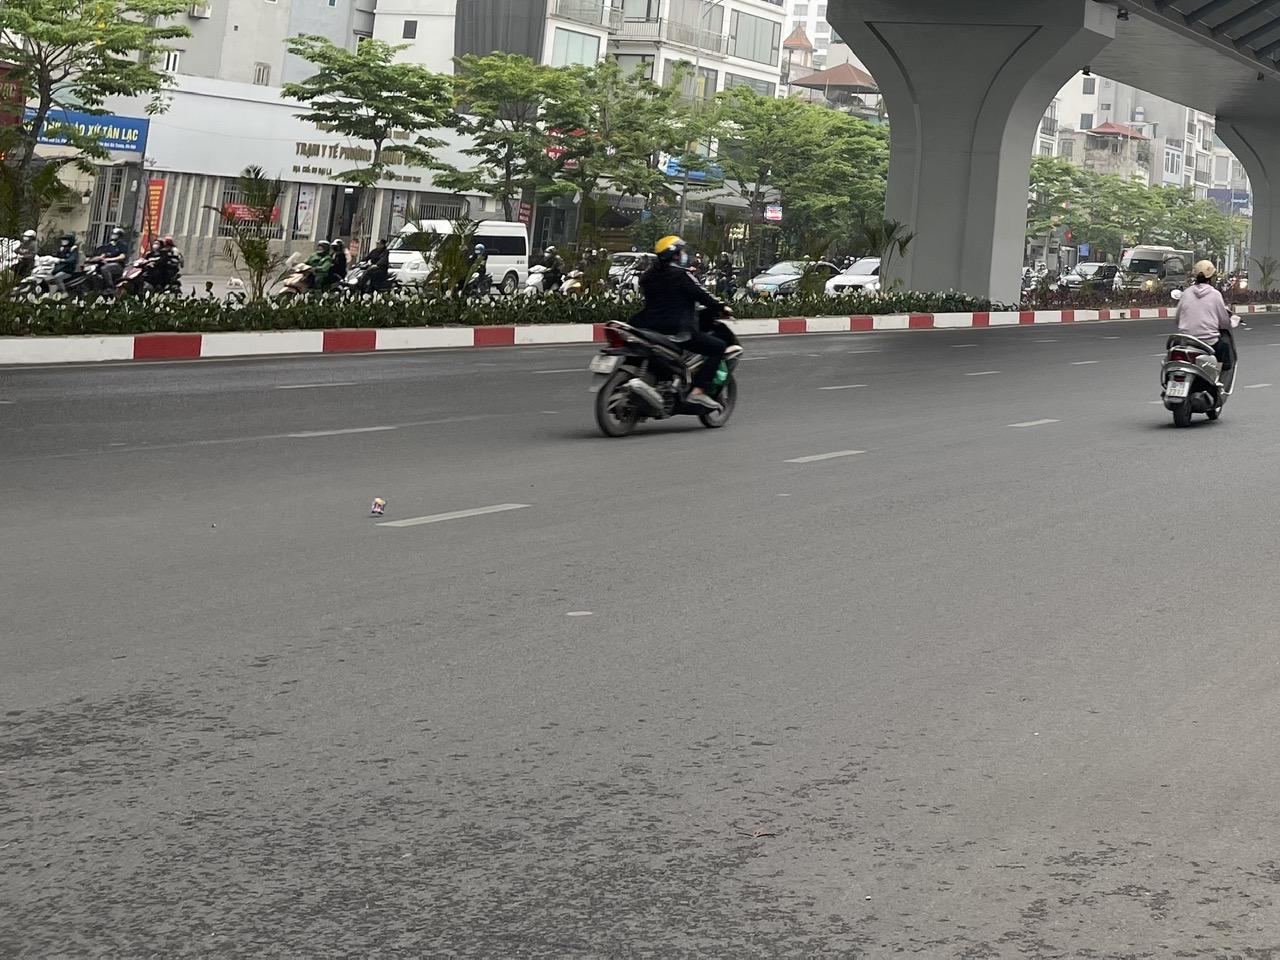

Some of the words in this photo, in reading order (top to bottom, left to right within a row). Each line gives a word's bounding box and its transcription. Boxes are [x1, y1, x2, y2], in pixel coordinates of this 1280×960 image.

[102, 125, 120, 140] TÂN
[121, 128, 139, 143] LẠC
[295, 141, 320, 159] TRẠM
[320, 145, 328, 158] Y
[328, 142, 339, 159] TẾ
[339, 145, 372, 162] PHƯỜNG
[326, 168, 333, 176] LA
